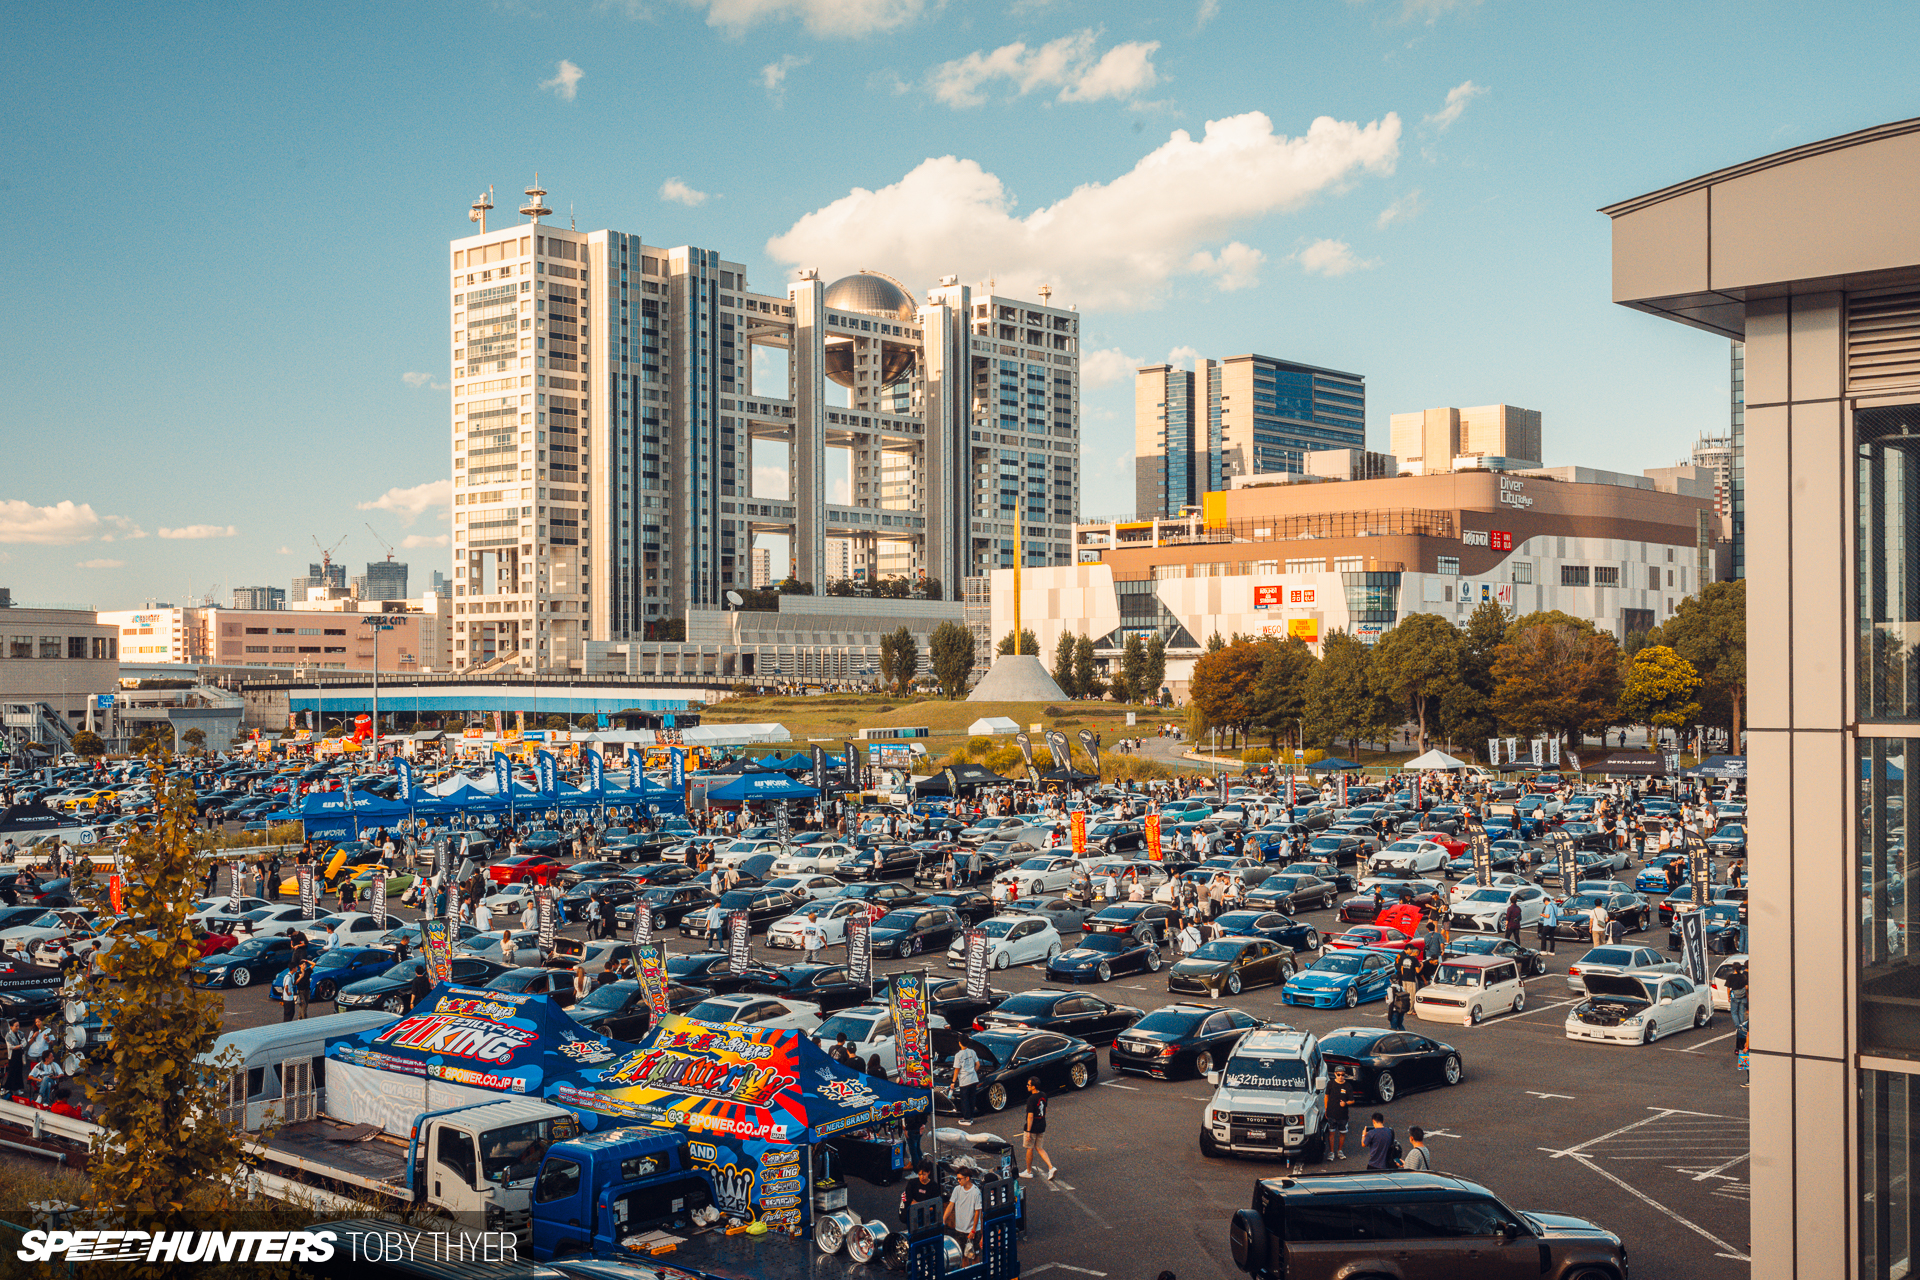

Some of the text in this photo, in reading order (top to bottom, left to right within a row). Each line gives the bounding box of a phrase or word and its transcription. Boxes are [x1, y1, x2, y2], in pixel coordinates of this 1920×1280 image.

[1501, 477, 1524, 491] Diver
[1501, 490, 1519, 508] City
[1482, 589, 1489, 597] GU
[1498, 585, 1511, 603] H&M
[1262, 625, 1282, 634] WEGO
[687, 1019, 763, 1034] TUNERS BRAND
[427, 1064, 512, 1089] @326POWER.CO.JP
[668, 1109, 771, 1136] @326POWER.CO.JP
[816, 1113, 870, 1133] TUNERS BRAND
[771, 1131, 786, 1140] JAPAN
[690, 1143, 715, 1160] AND
[718, 1196, 744, 1211] 326
